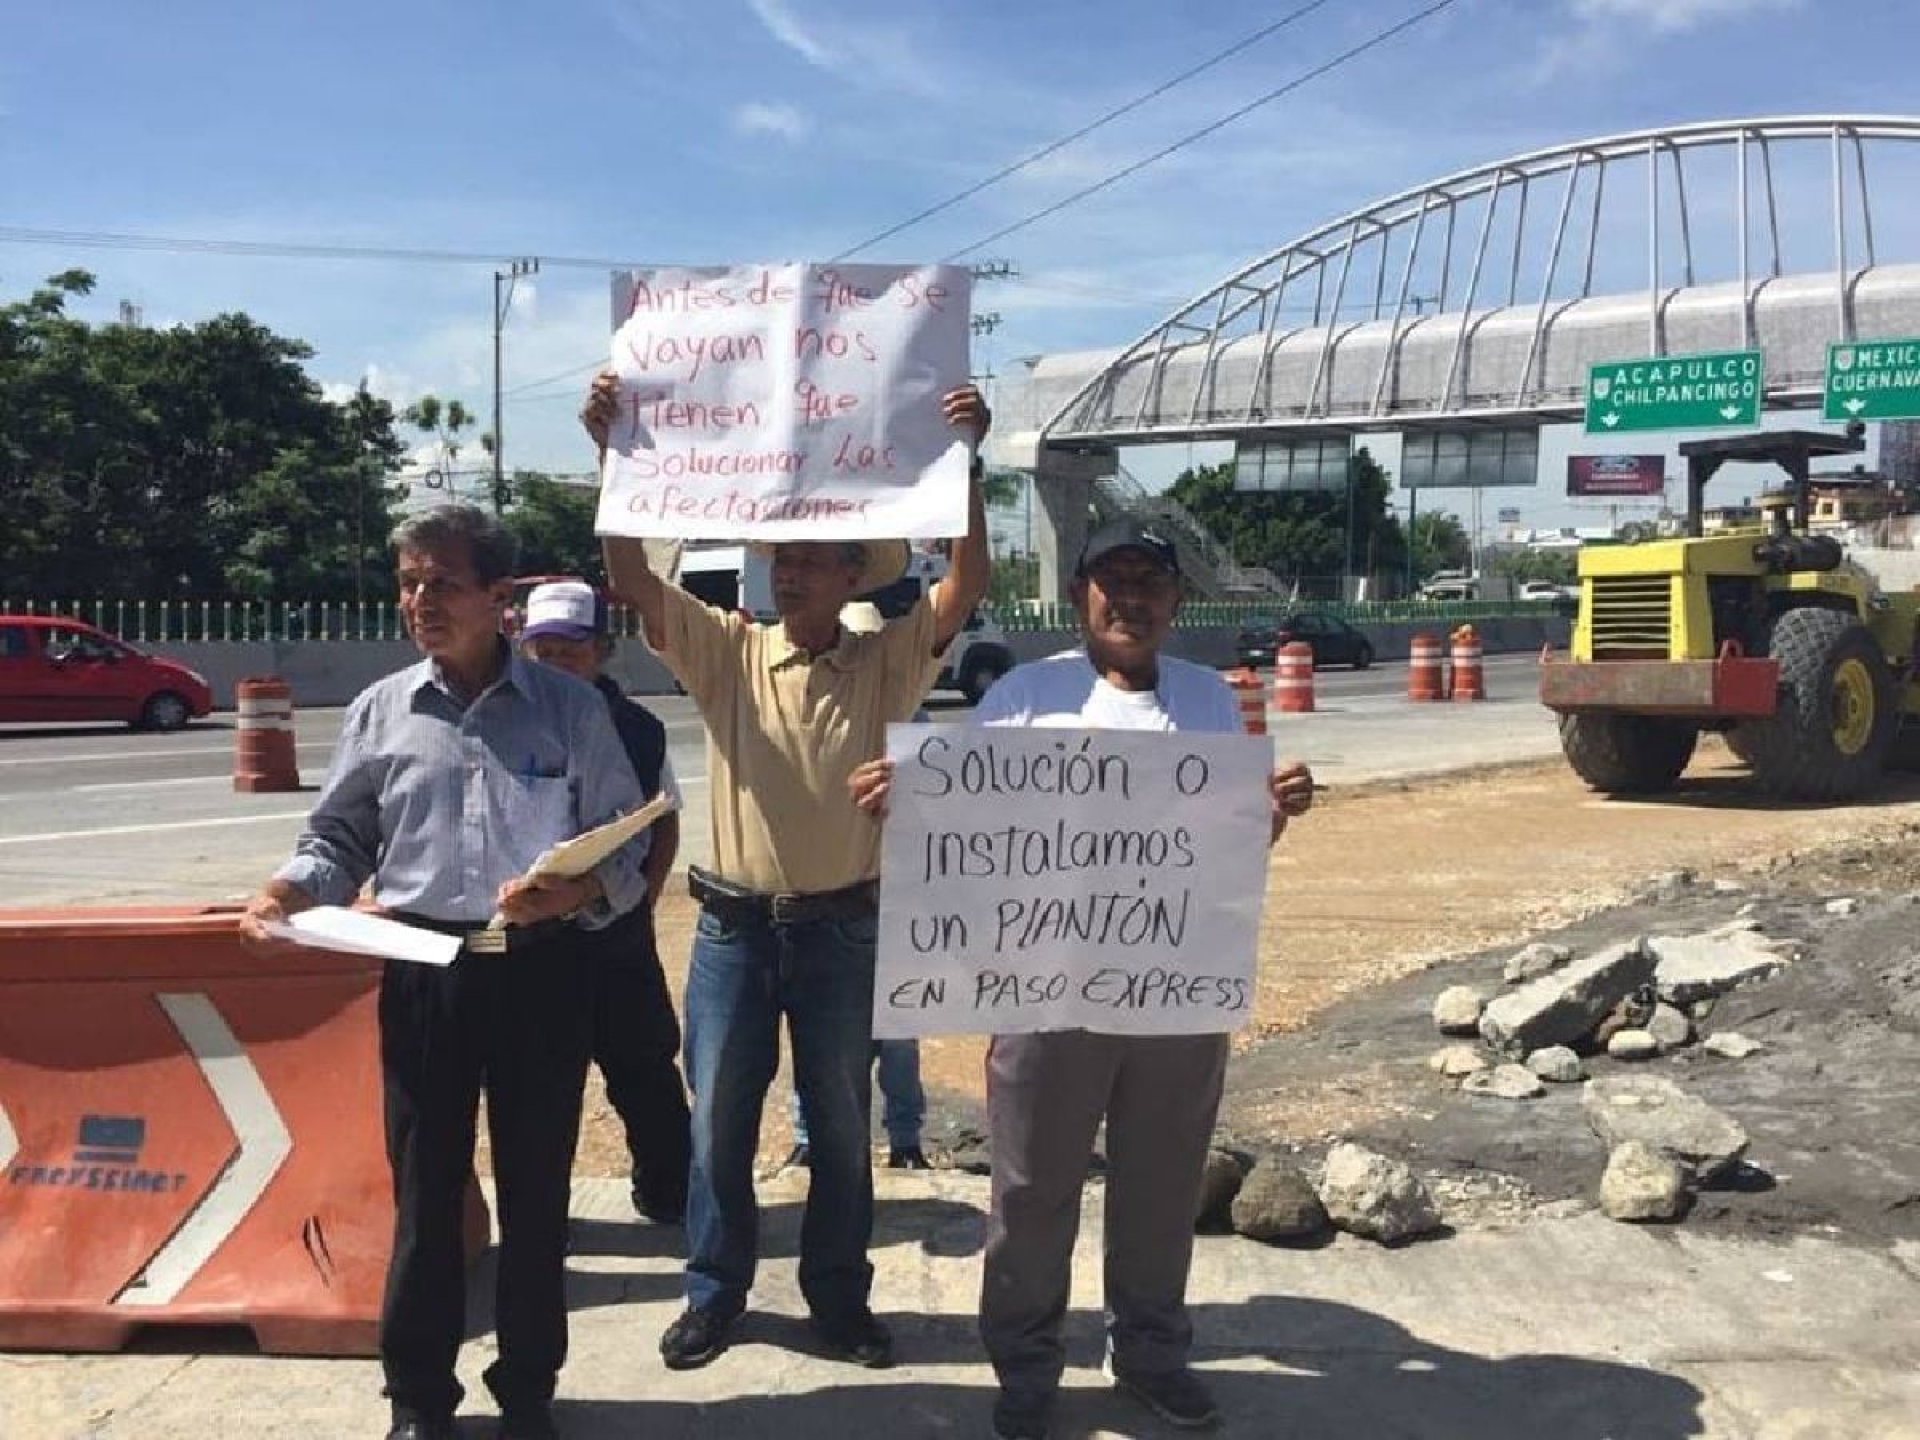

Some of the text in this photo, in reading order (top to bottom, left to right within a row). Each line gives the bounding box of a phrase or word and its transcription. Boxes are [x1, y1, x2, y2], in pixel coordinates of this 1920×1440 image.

[627, 279, 736, 317] Antes
[748, 269, 795, 307] de
[794, 326, 878, 362] nos
[1858, 346, 1920, 368] MEXIC
[1614, 358, 1757, 386] ACAPULCO
[1612, 379, 1756, 408] CHILPANCINGO
[912, 735, 1131, 801] Solución
[910, 911, 968, 954] un
[888, 977, 946, 1010] EN
[973, 970, 1069, 1010] PASO
